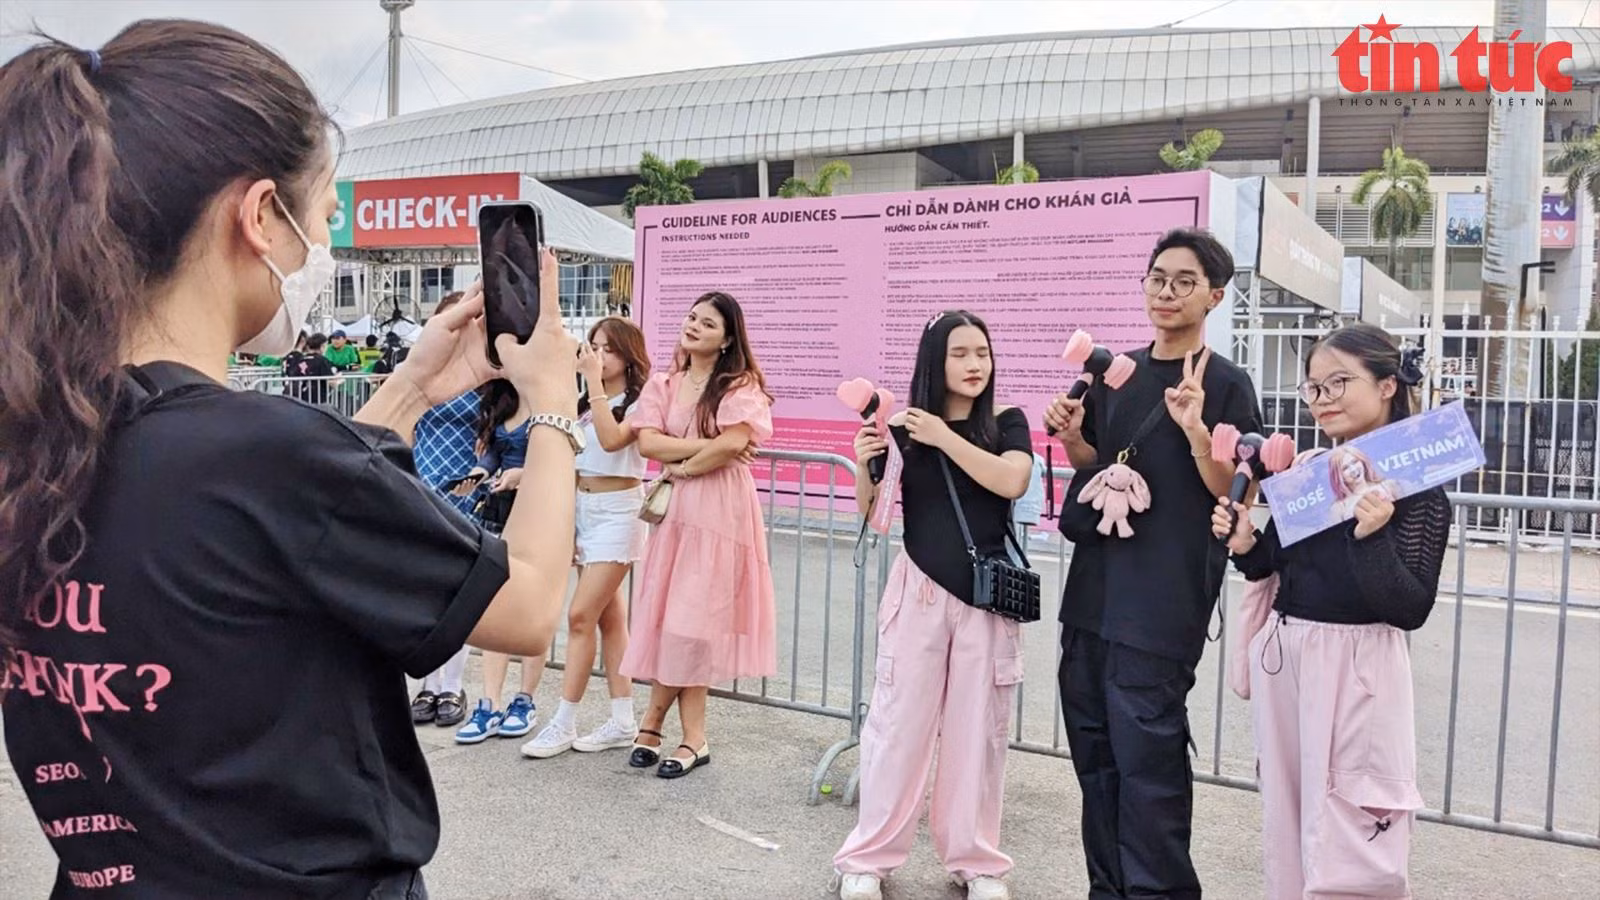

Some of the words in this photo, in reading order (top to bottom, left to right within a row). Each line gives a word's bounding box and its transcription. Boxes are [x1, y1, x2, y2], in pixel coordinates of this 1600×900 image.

[356, 194, 504, 231] CHECK-I
[954, 197, 1000, 214] DÀNH
[1005, 196, 1040, 211] CHO
[1046, 190, 1095, 208] KHÁN
[1101, 186, 1132, 205] GIẢ
[661, 214, 728, 229] GUIDELINE
[731, 212, 758, 226] FOR
[761, 208, 837, 224] AUDIENCES
[661, 232, 717, 243] INSTRUCTIONS
[719, 231, 750, 241] NEEDED
[1377, 434, 1465, 473] VIETNAM
[1286, 486, 1326, 516] ROSÉ
[24, 579, 107, 633] OU
